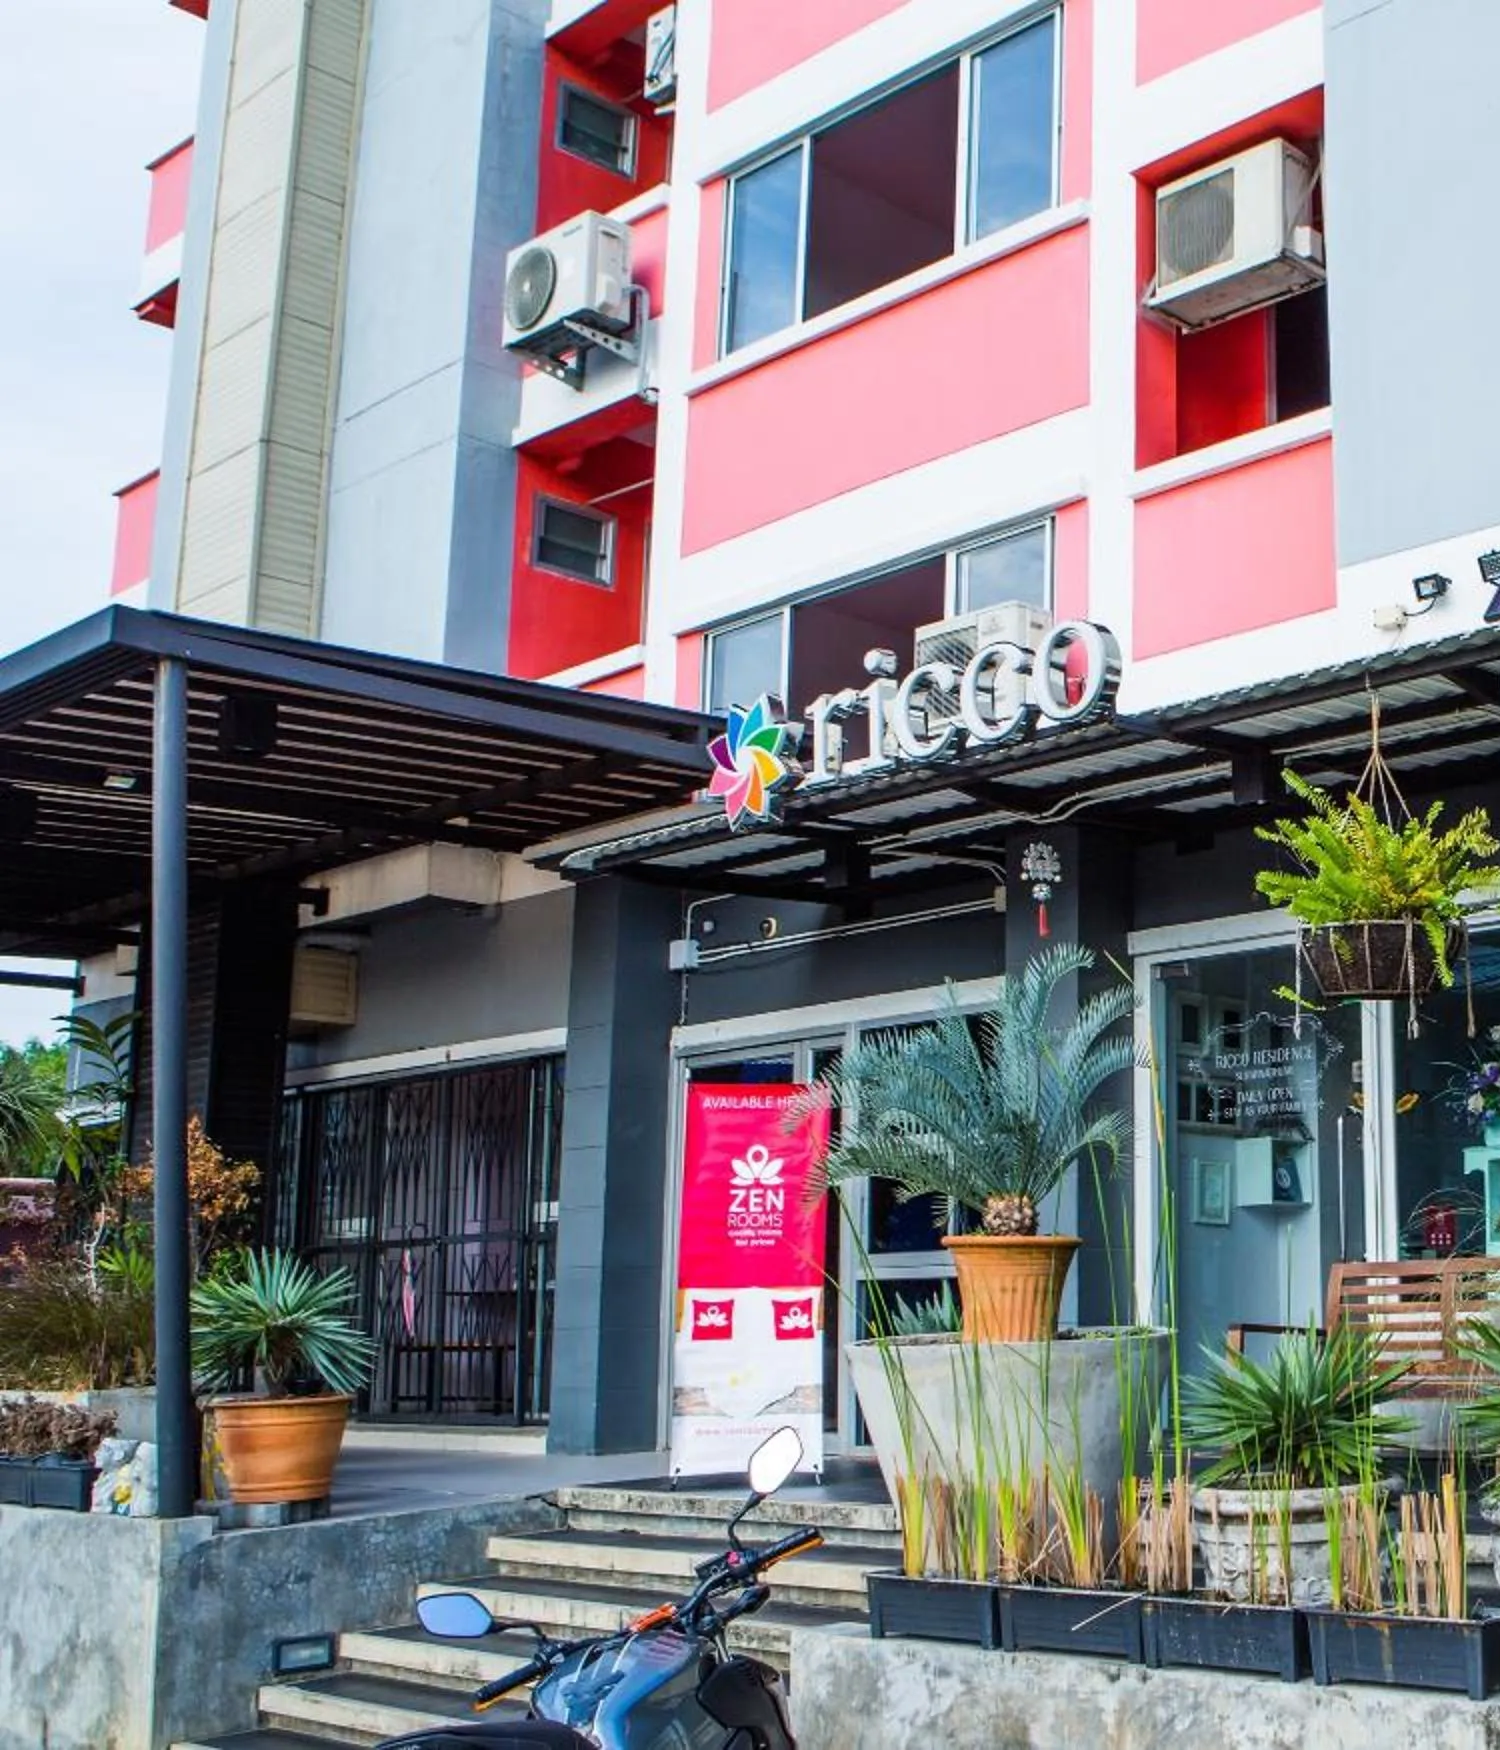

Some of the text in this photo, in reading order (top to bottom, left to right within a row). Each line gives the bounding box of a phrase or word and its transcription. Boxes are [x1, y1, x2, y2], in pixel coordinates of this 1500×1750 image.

[797, 620, 1120, 790] ricco
[703, 1095, 774, 1109] AVAILABLE
[729, 1189, 785, 1212] ZEN
[727, 1213, 783, 1227] ROOMS
